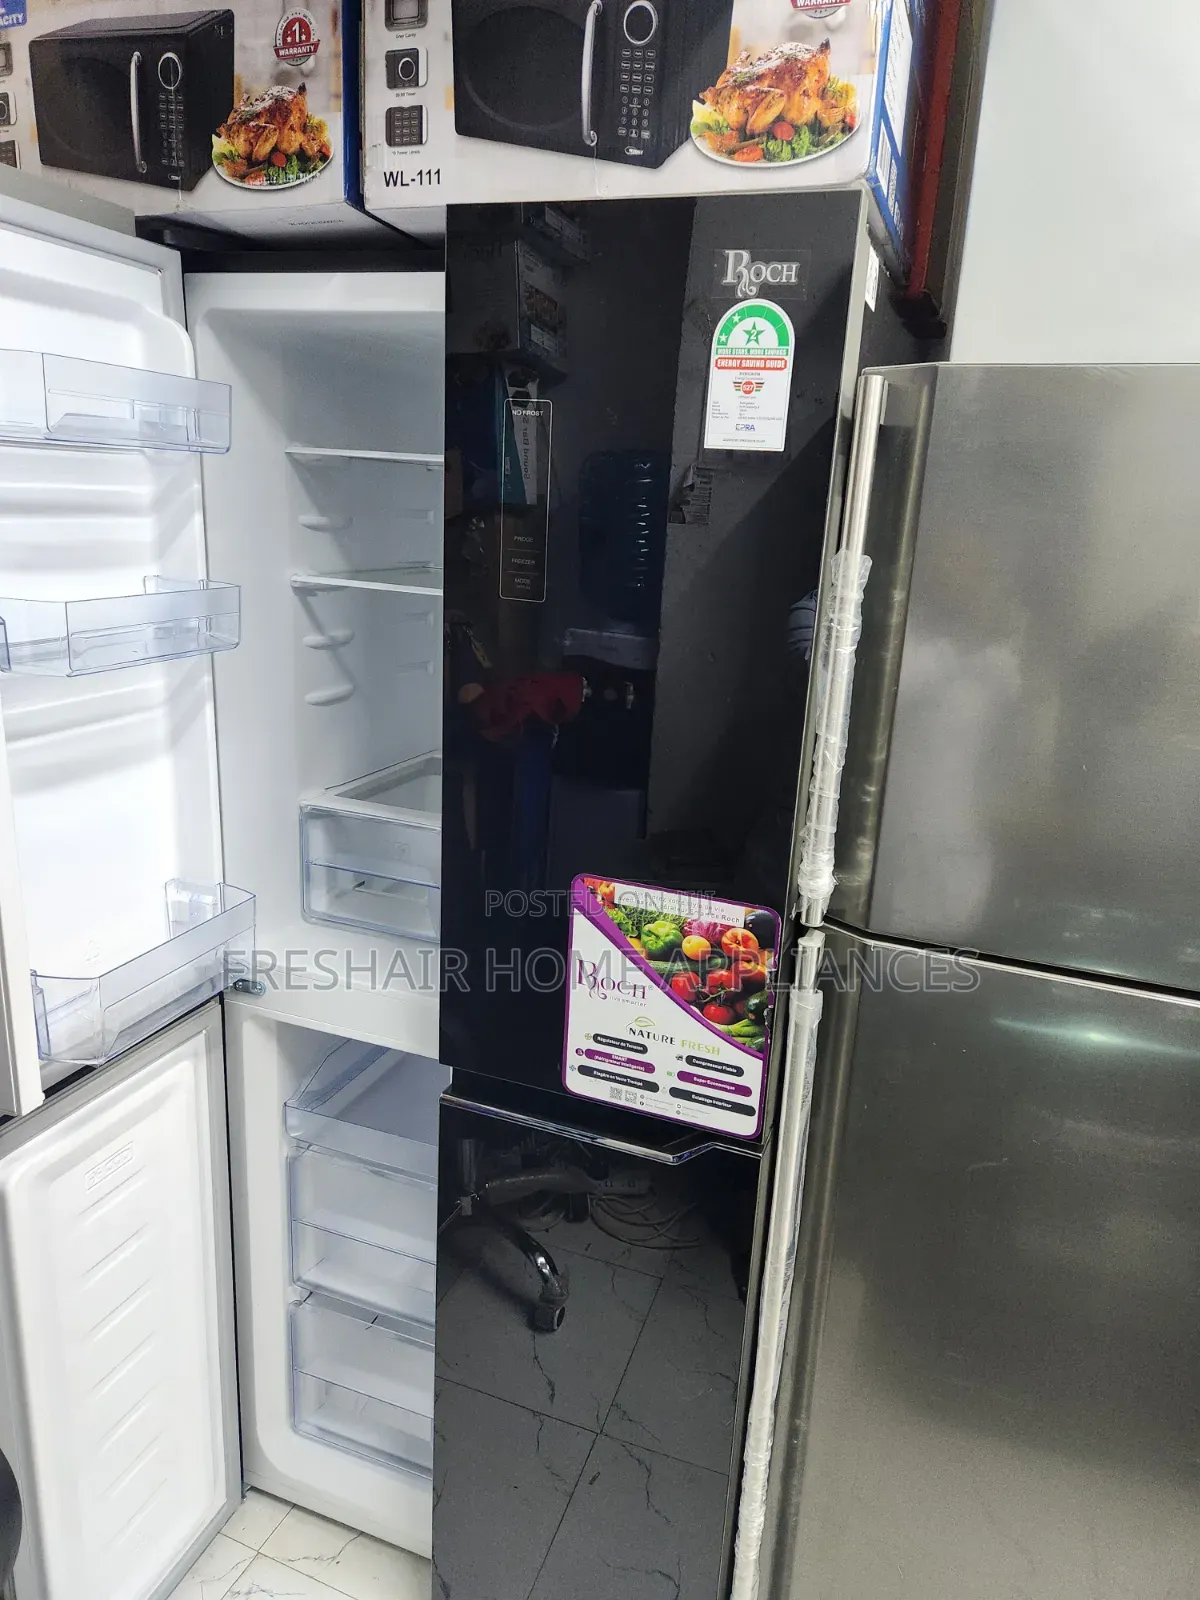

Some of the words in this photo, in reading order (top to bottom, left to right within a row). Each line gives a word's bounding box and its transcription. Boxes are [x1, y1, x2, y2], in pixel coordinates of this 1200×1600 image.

[292, 21, 300, 43] 1
[279, 45, 315, 57] WARRANTY
[383, 168, 442, 188] WL-111
[750, 328, 758, 341] 2
[717, 359, 741, 367] ENERGY
[741, 359, 765, 367] SAVING
[765, 360, 786, 368] GUIDE
[721, 914, 740, 923] Roch
[621, 999, 647, 1007] smarter
[629, 1027, 676, 1046] NATURE
[681, 1039, 721, 1056] FRESH
